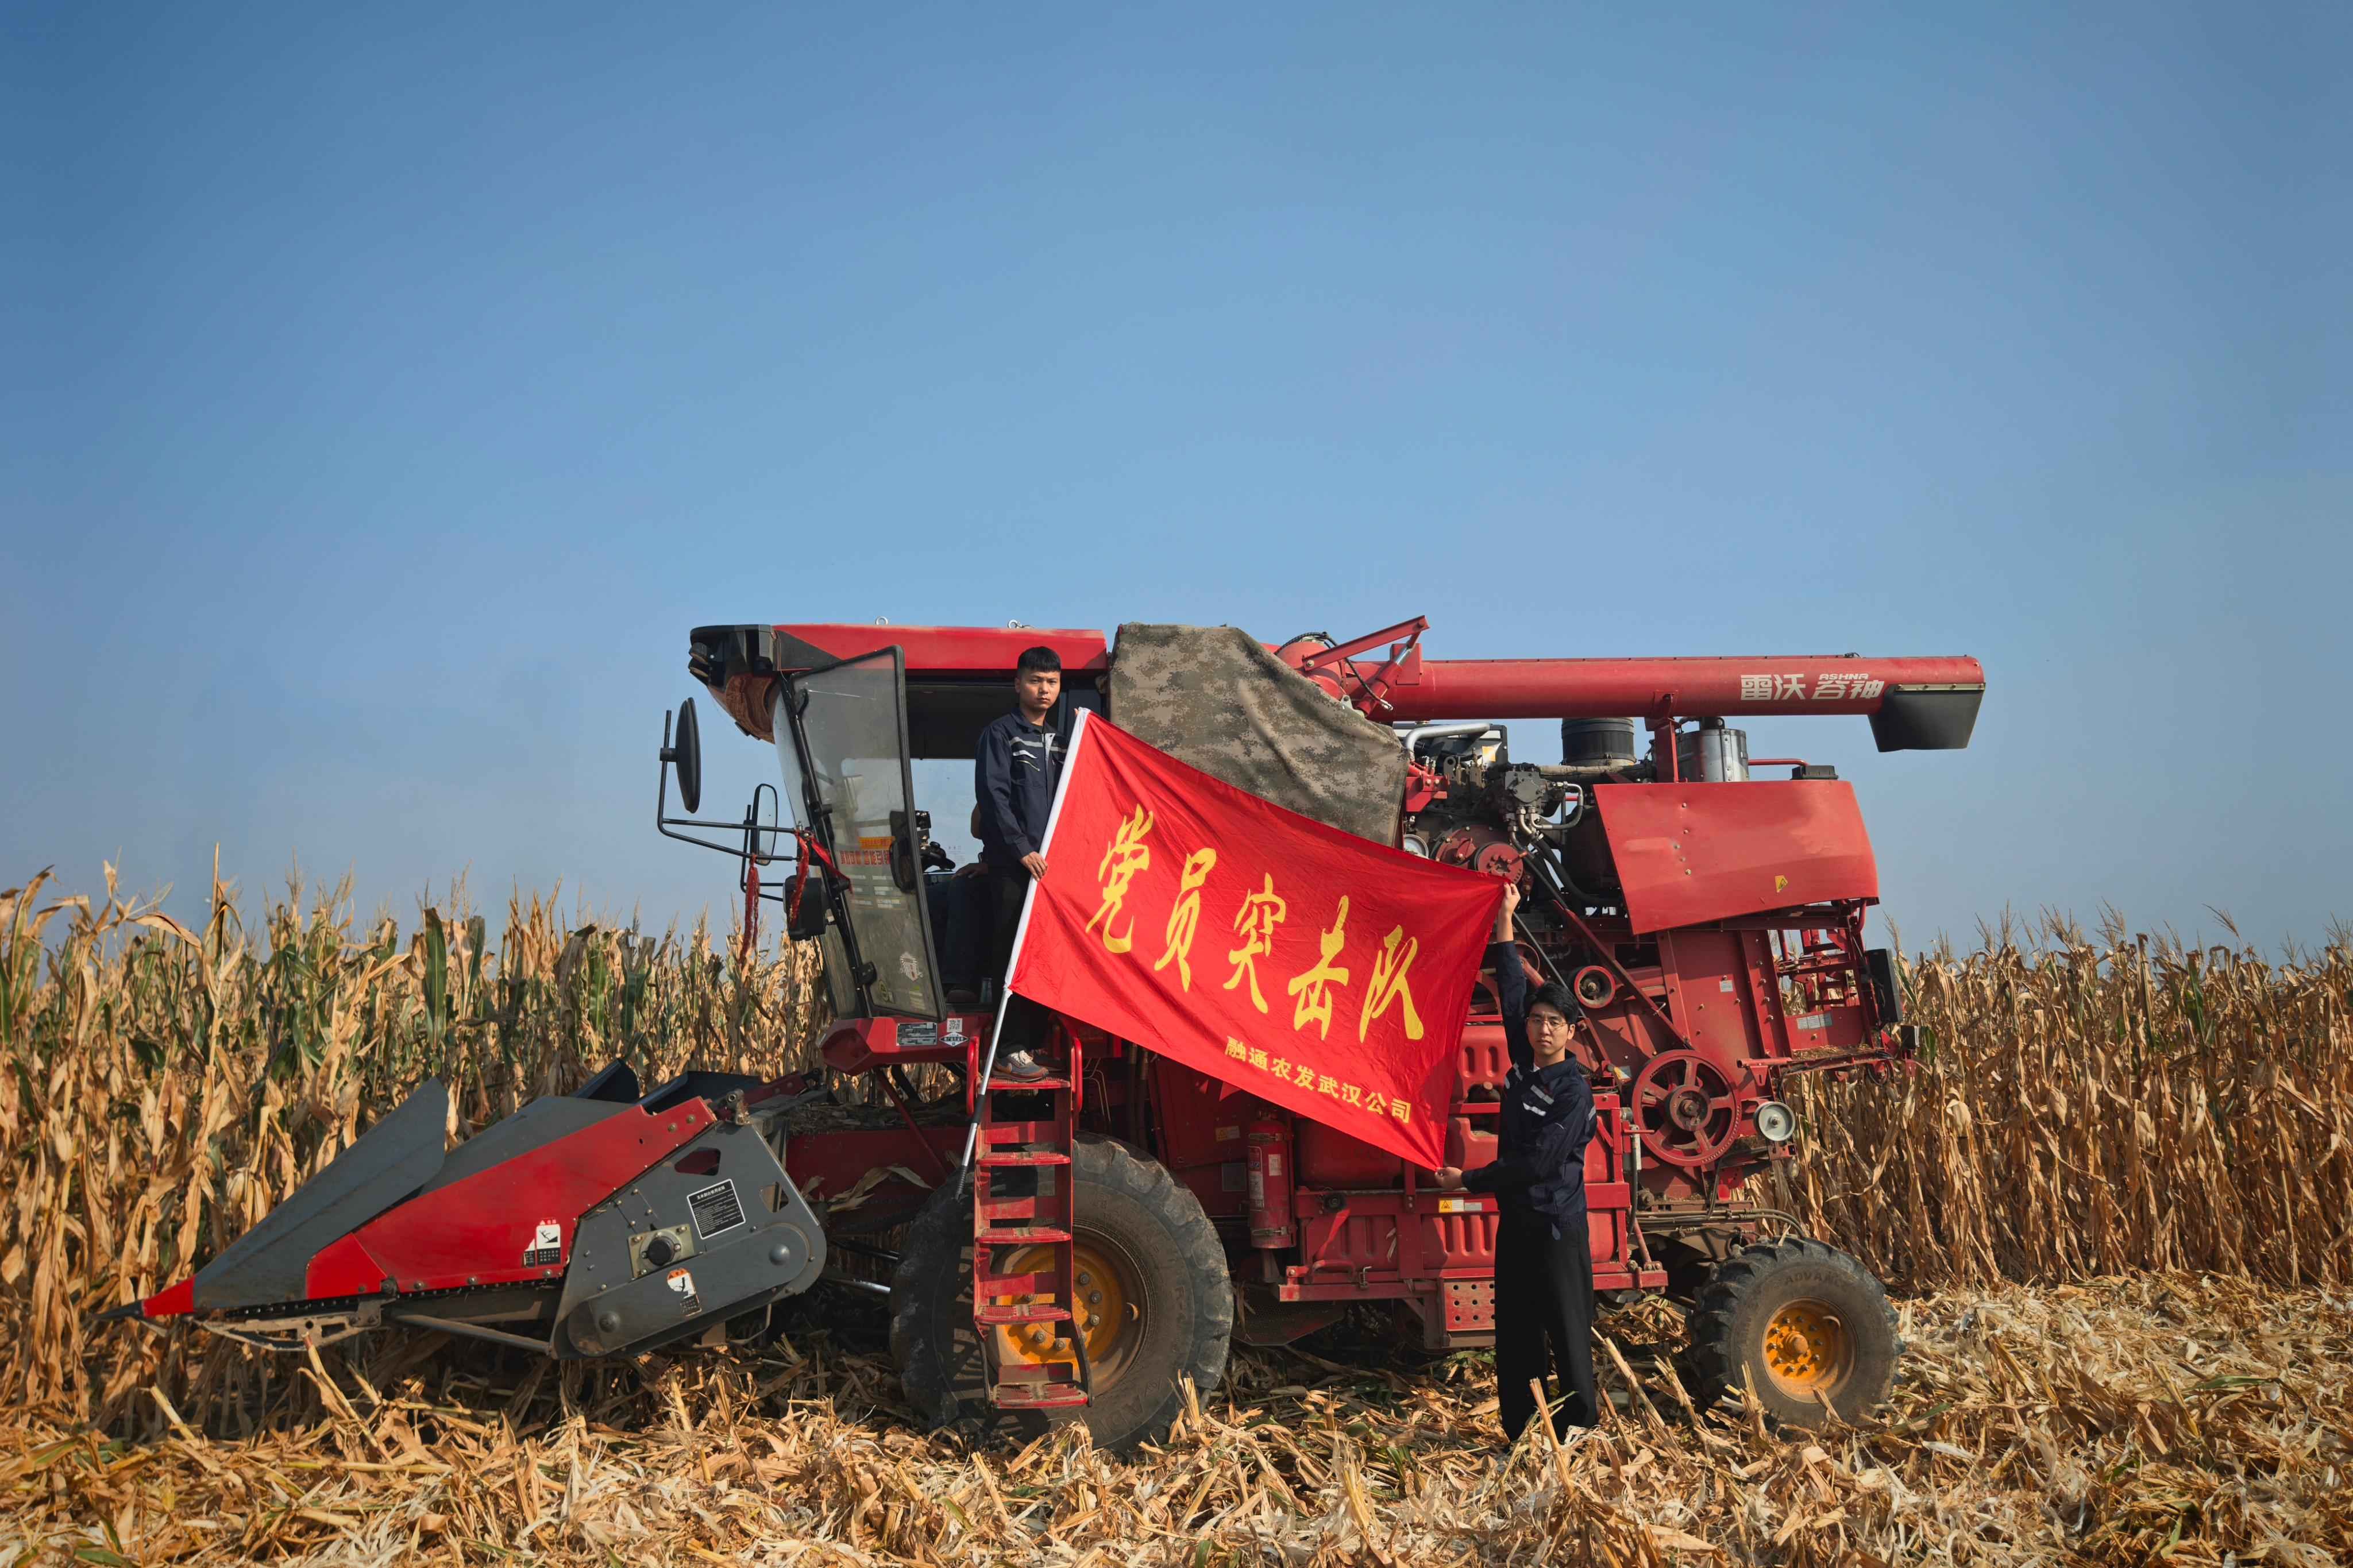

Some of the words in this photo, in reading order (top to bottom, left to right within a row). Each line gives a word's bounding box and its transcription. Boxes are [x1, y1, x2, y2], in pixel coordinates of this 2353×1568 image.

[1740, 673, 1807, 701] 雷沃
[1811, 679, 1885, 700] 谷神
[1085, 804, 1425, 1044] 党员突击队
[1224, 1036, 1412, 1124] 融通农发武汉公司
